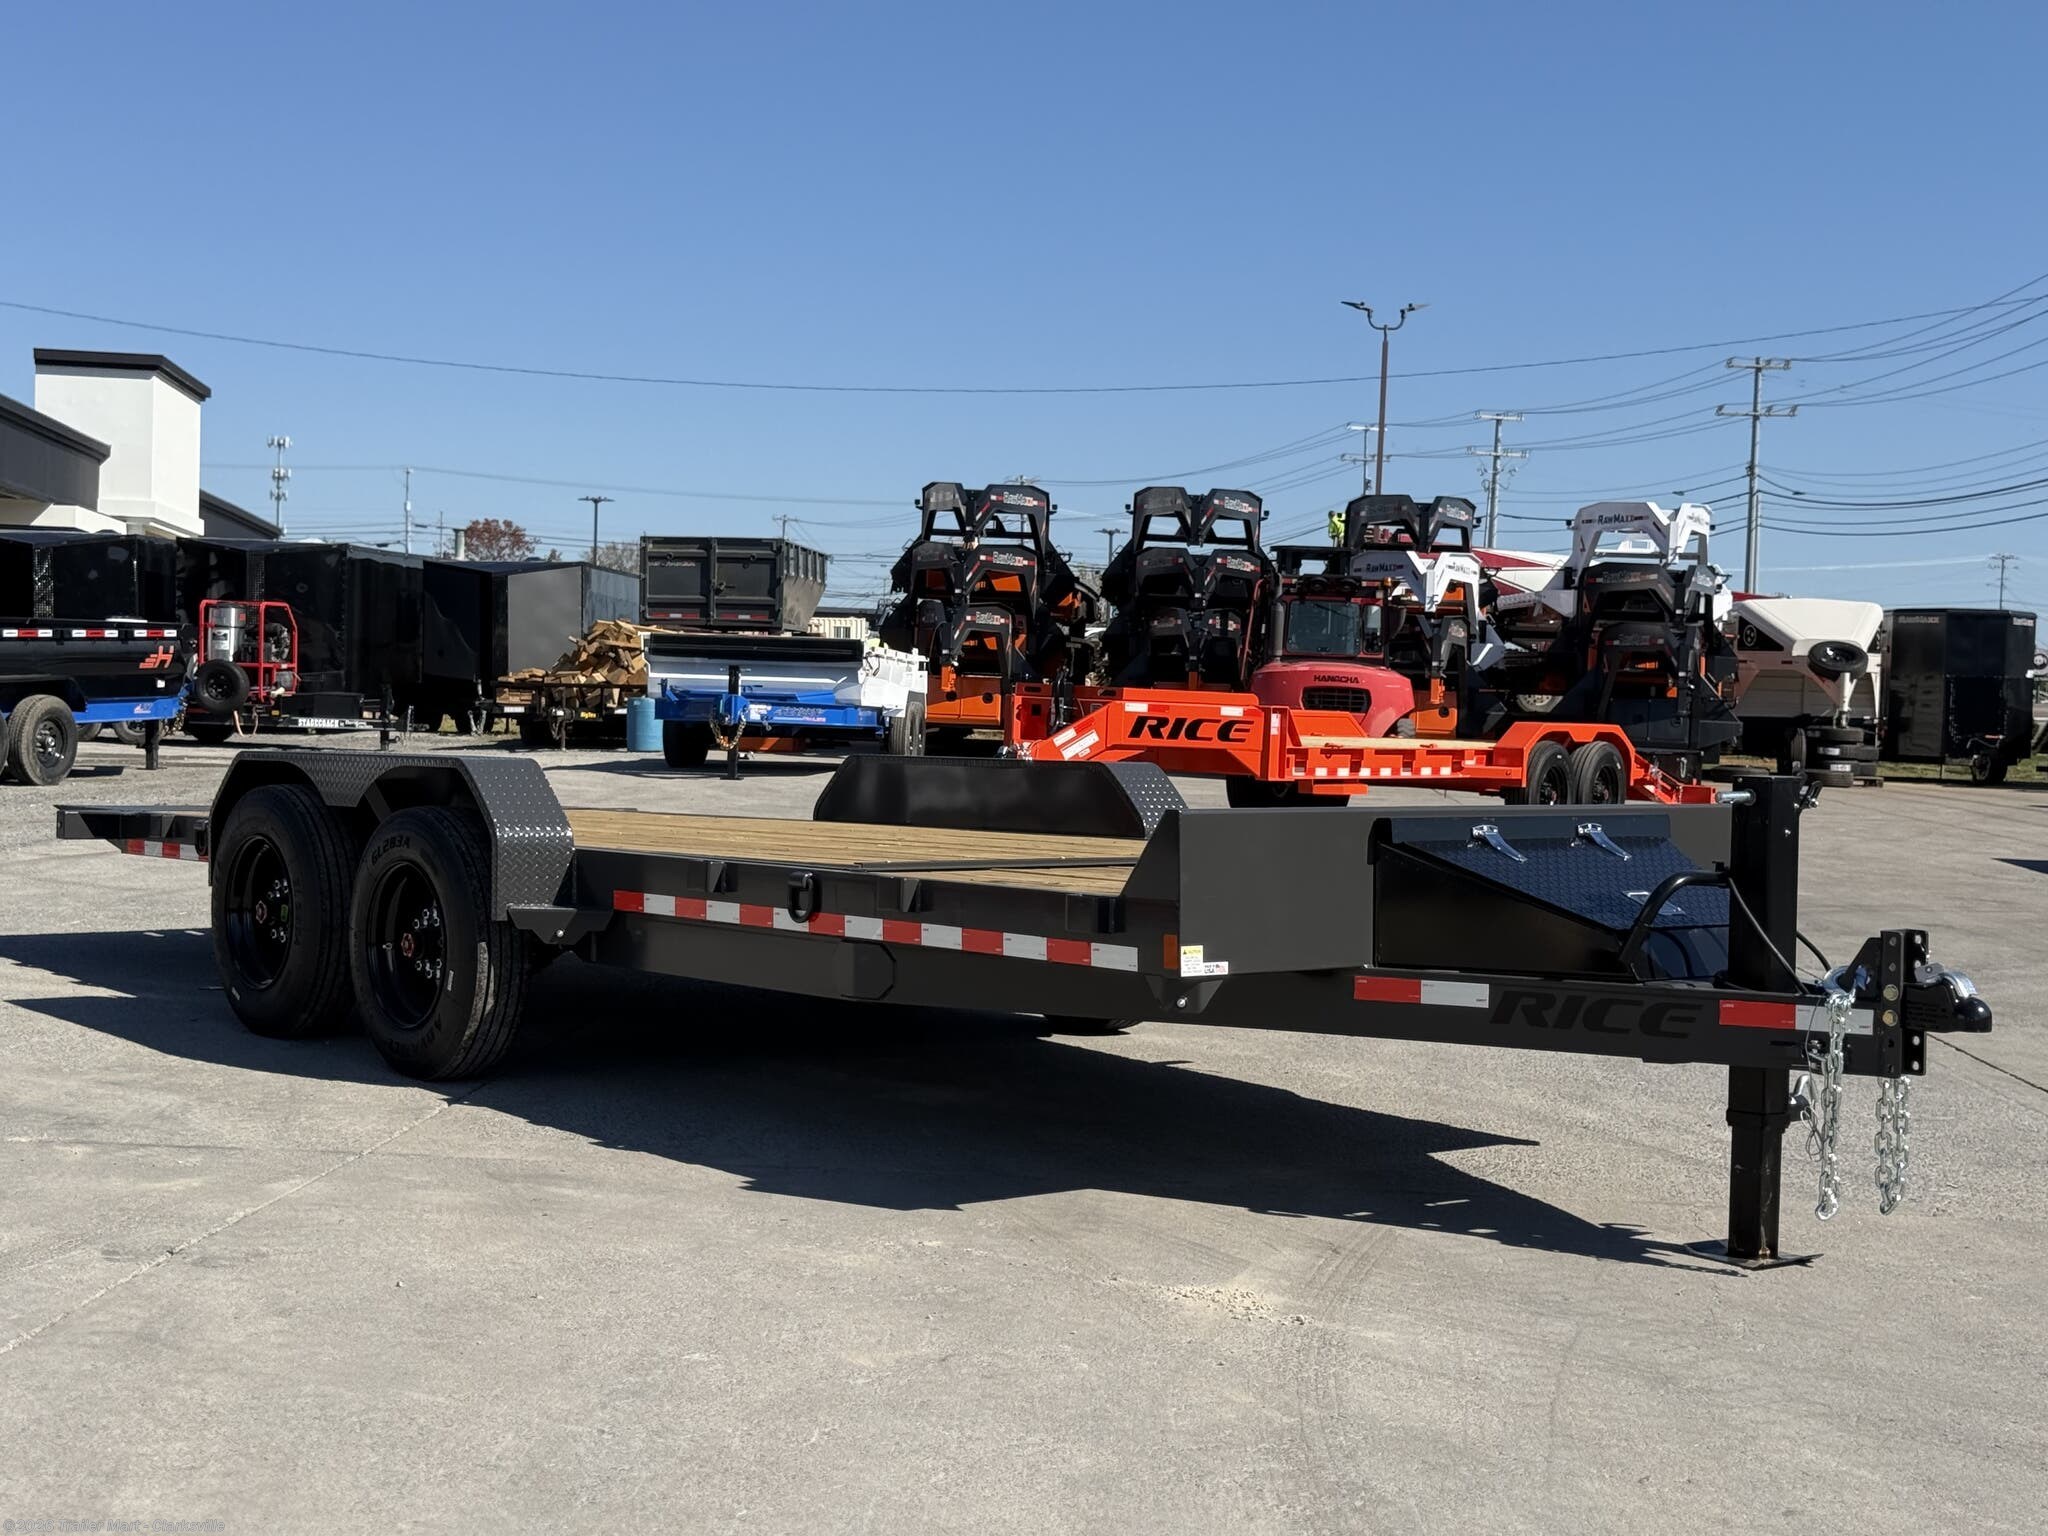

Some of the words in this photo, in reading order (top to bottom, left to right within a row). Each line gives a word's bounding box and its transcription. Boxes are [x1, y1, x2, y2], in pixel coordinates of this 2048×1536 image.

[1314, 675, 1360, 684] HANGCHA
[1128, 715, 1254, 743] RICE
[1489, 990, 1704, 1039] RICE
